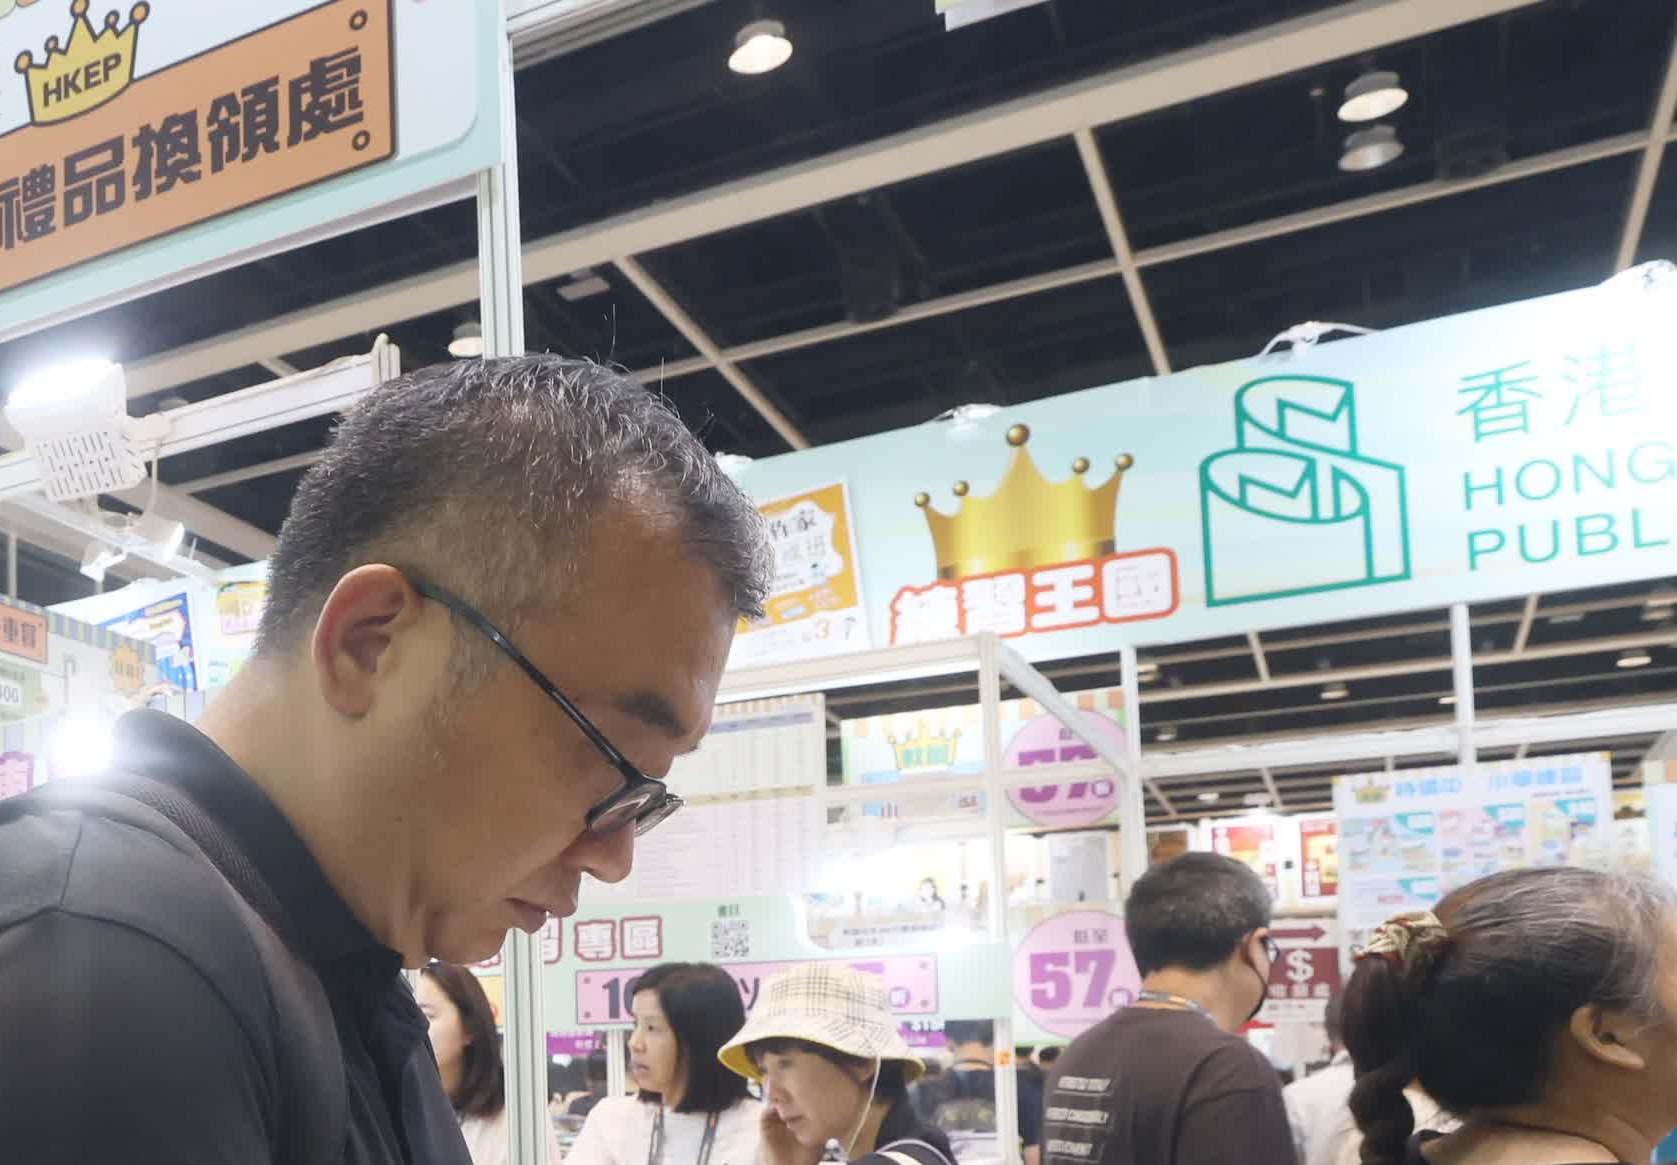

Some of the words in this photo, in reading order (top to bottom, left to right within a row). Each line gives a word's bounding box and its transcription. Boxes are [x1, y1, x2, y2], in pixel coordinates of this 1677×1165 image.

[42, 52, 123, 108] HKEP
[1456, 343, 1650, 444] 香港
[1463, 440, 1677, 511] HONG
[1467, 506, 1671, 572] PUBL
